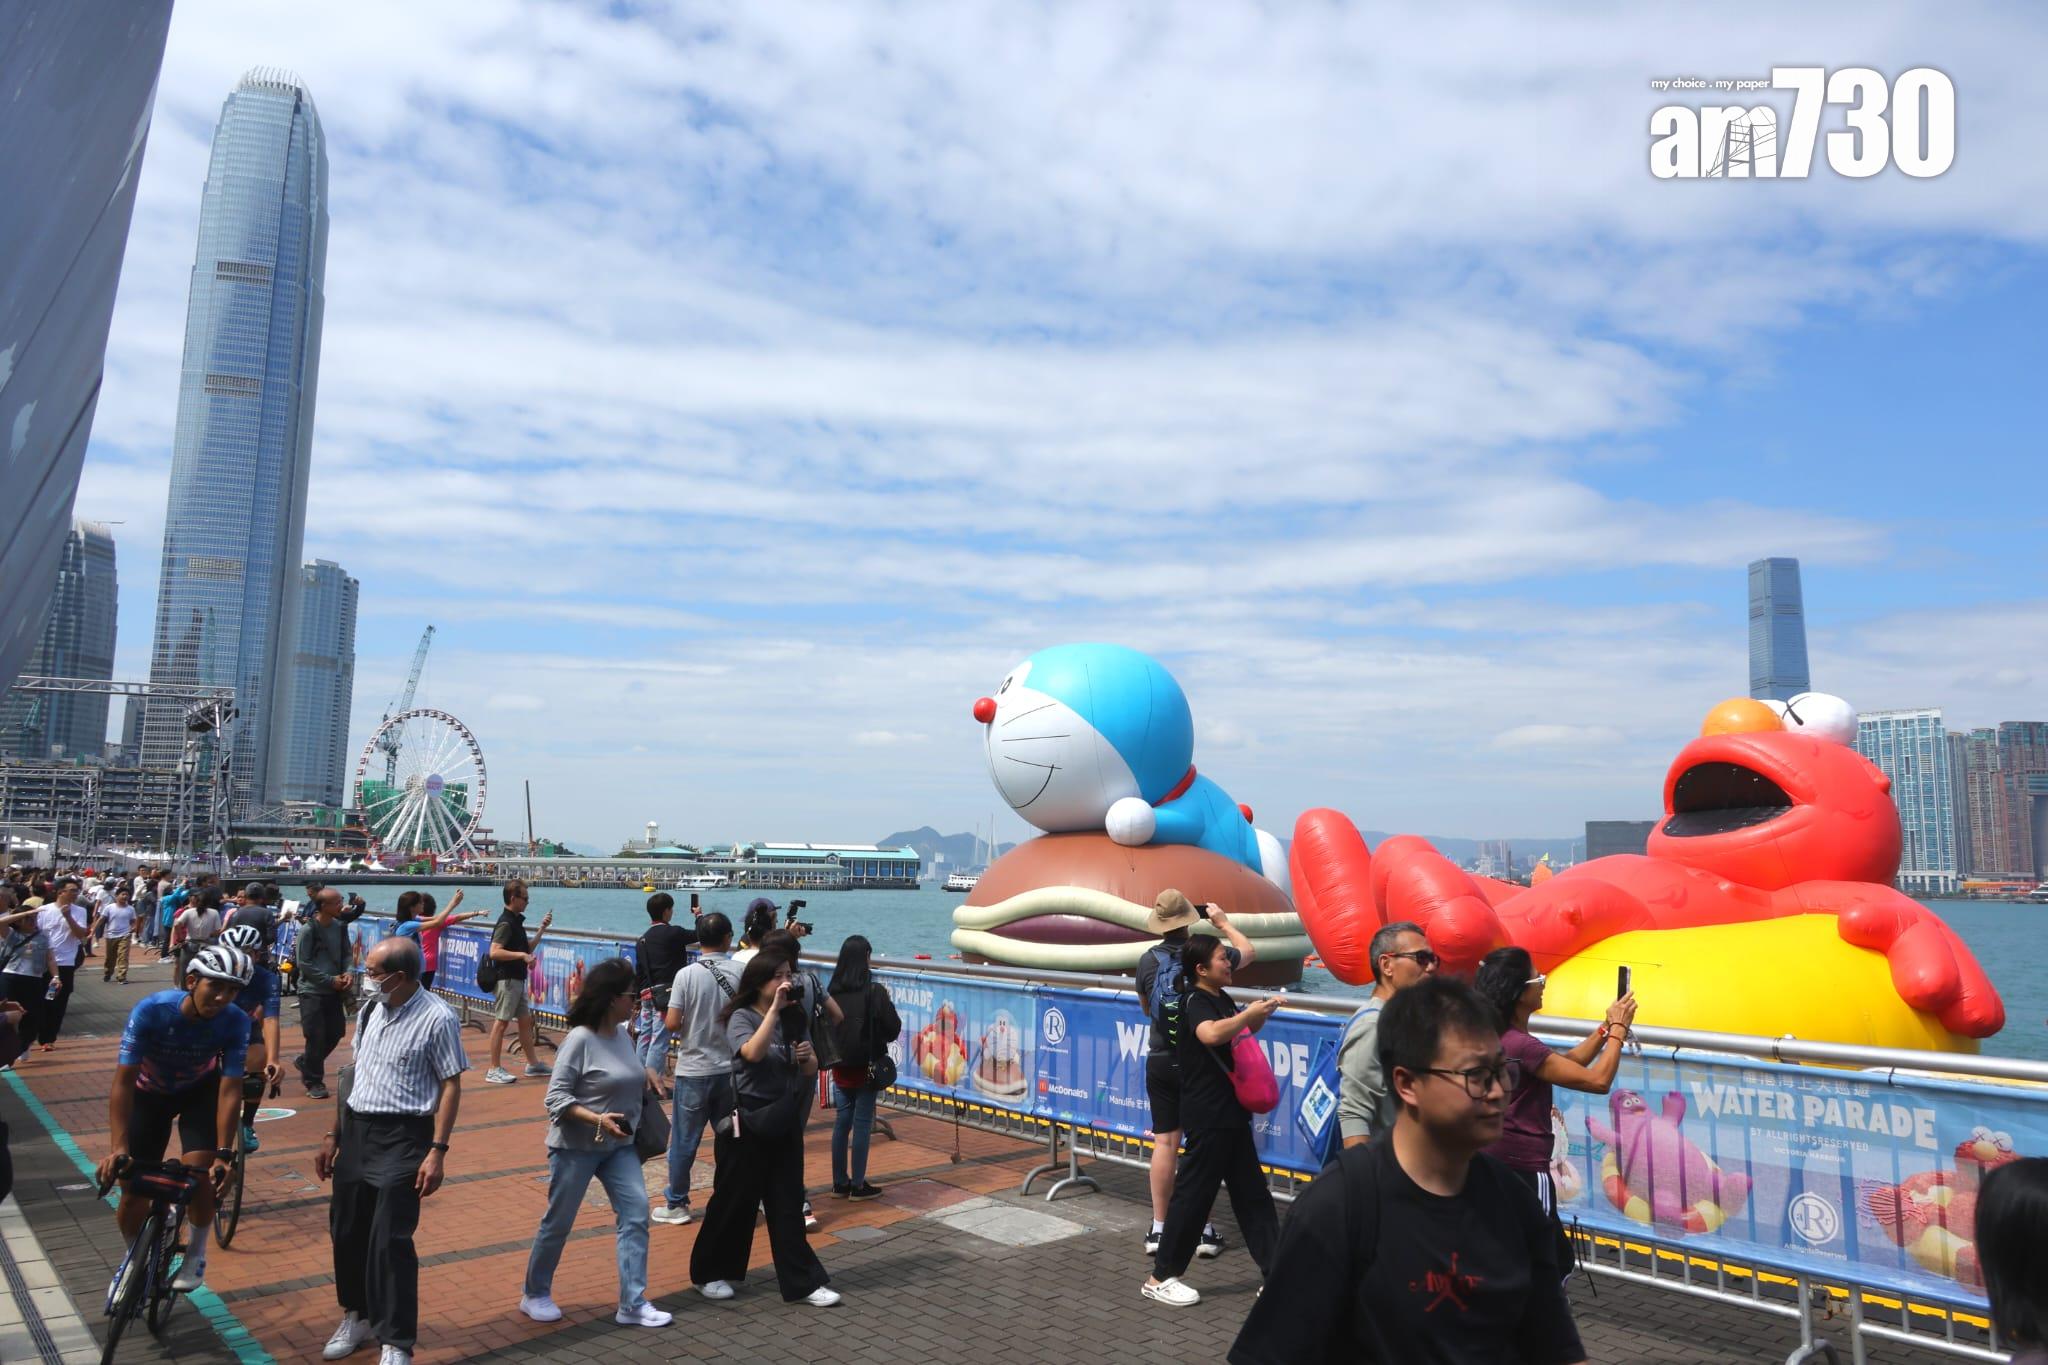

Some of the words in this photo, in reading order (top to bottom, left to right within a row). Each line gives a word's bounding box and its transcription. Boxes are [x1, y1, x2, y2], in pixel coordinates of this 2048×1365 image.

[895, 987, 934, 1013] PARADE
[1048, 1084, 1089, 1099] McDonald's
[1109, 1095, 1135, 1108] Manulife
[1690, 1081, 1797, 1121] WATER
[1803, 1095, 1938, 1151] PARADE
[1750, 1127, 1762, 1137] BY
[1766, 1129, 1869, 1152] ALLRIGHTSRESERVED
